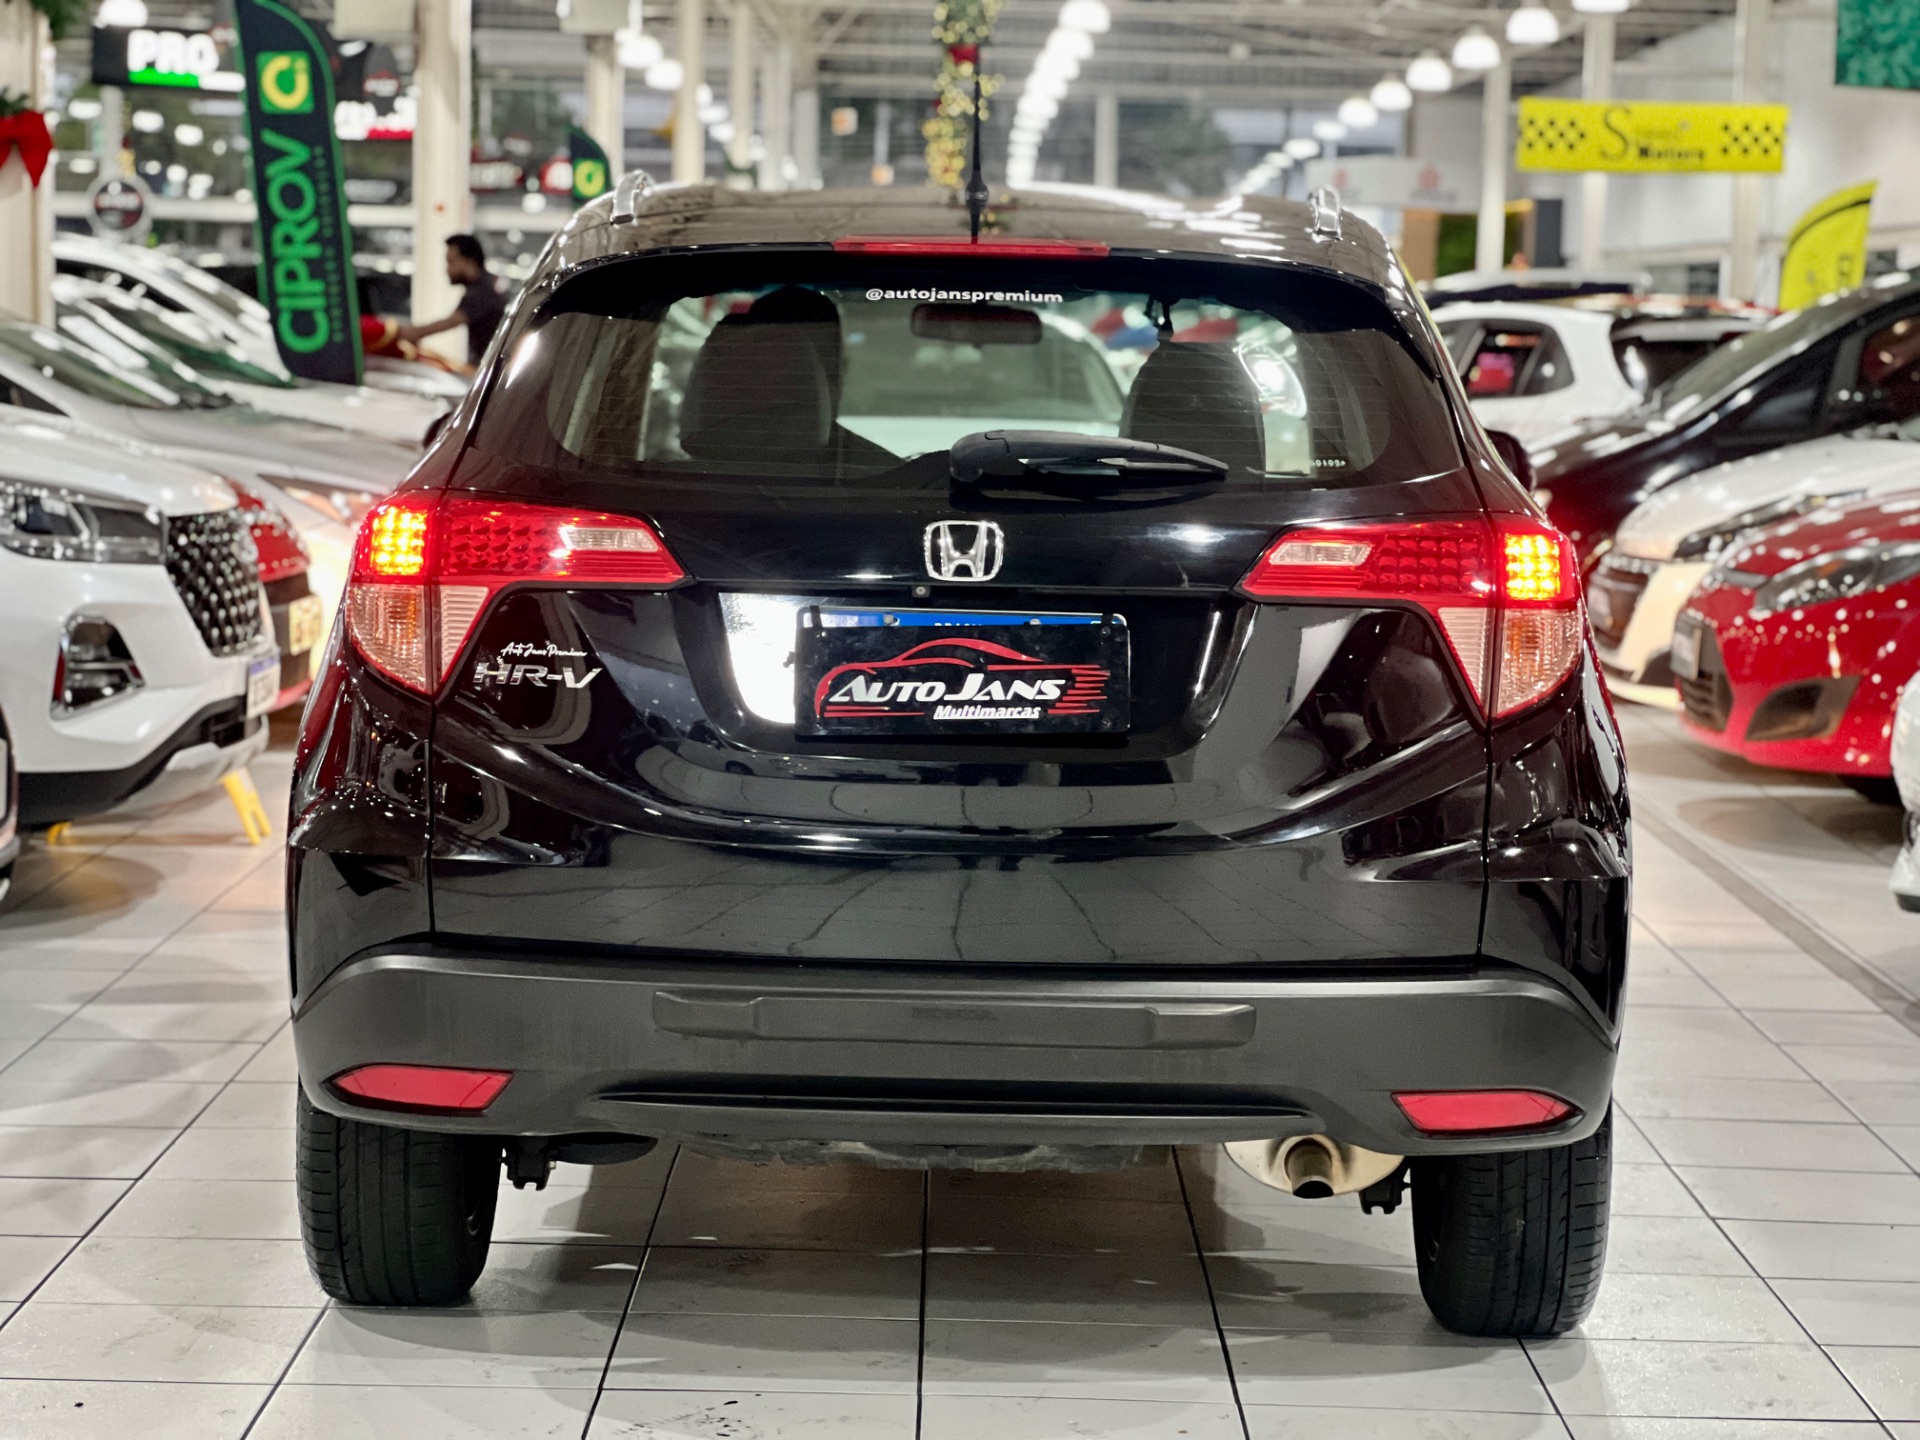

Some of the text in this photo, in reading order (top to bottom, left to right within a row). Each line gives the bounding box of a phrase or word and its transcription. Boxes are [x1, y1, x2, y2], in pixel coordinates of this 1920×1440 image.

[127, 29, 220, 74] PRO
[259, 127, 331, 354] CIPROV
[865, 287, 1064, 303] @autojanspremium
[472, 661, 603, 689] HR-V
[933, 703, 1042, 720] Multimarcas
